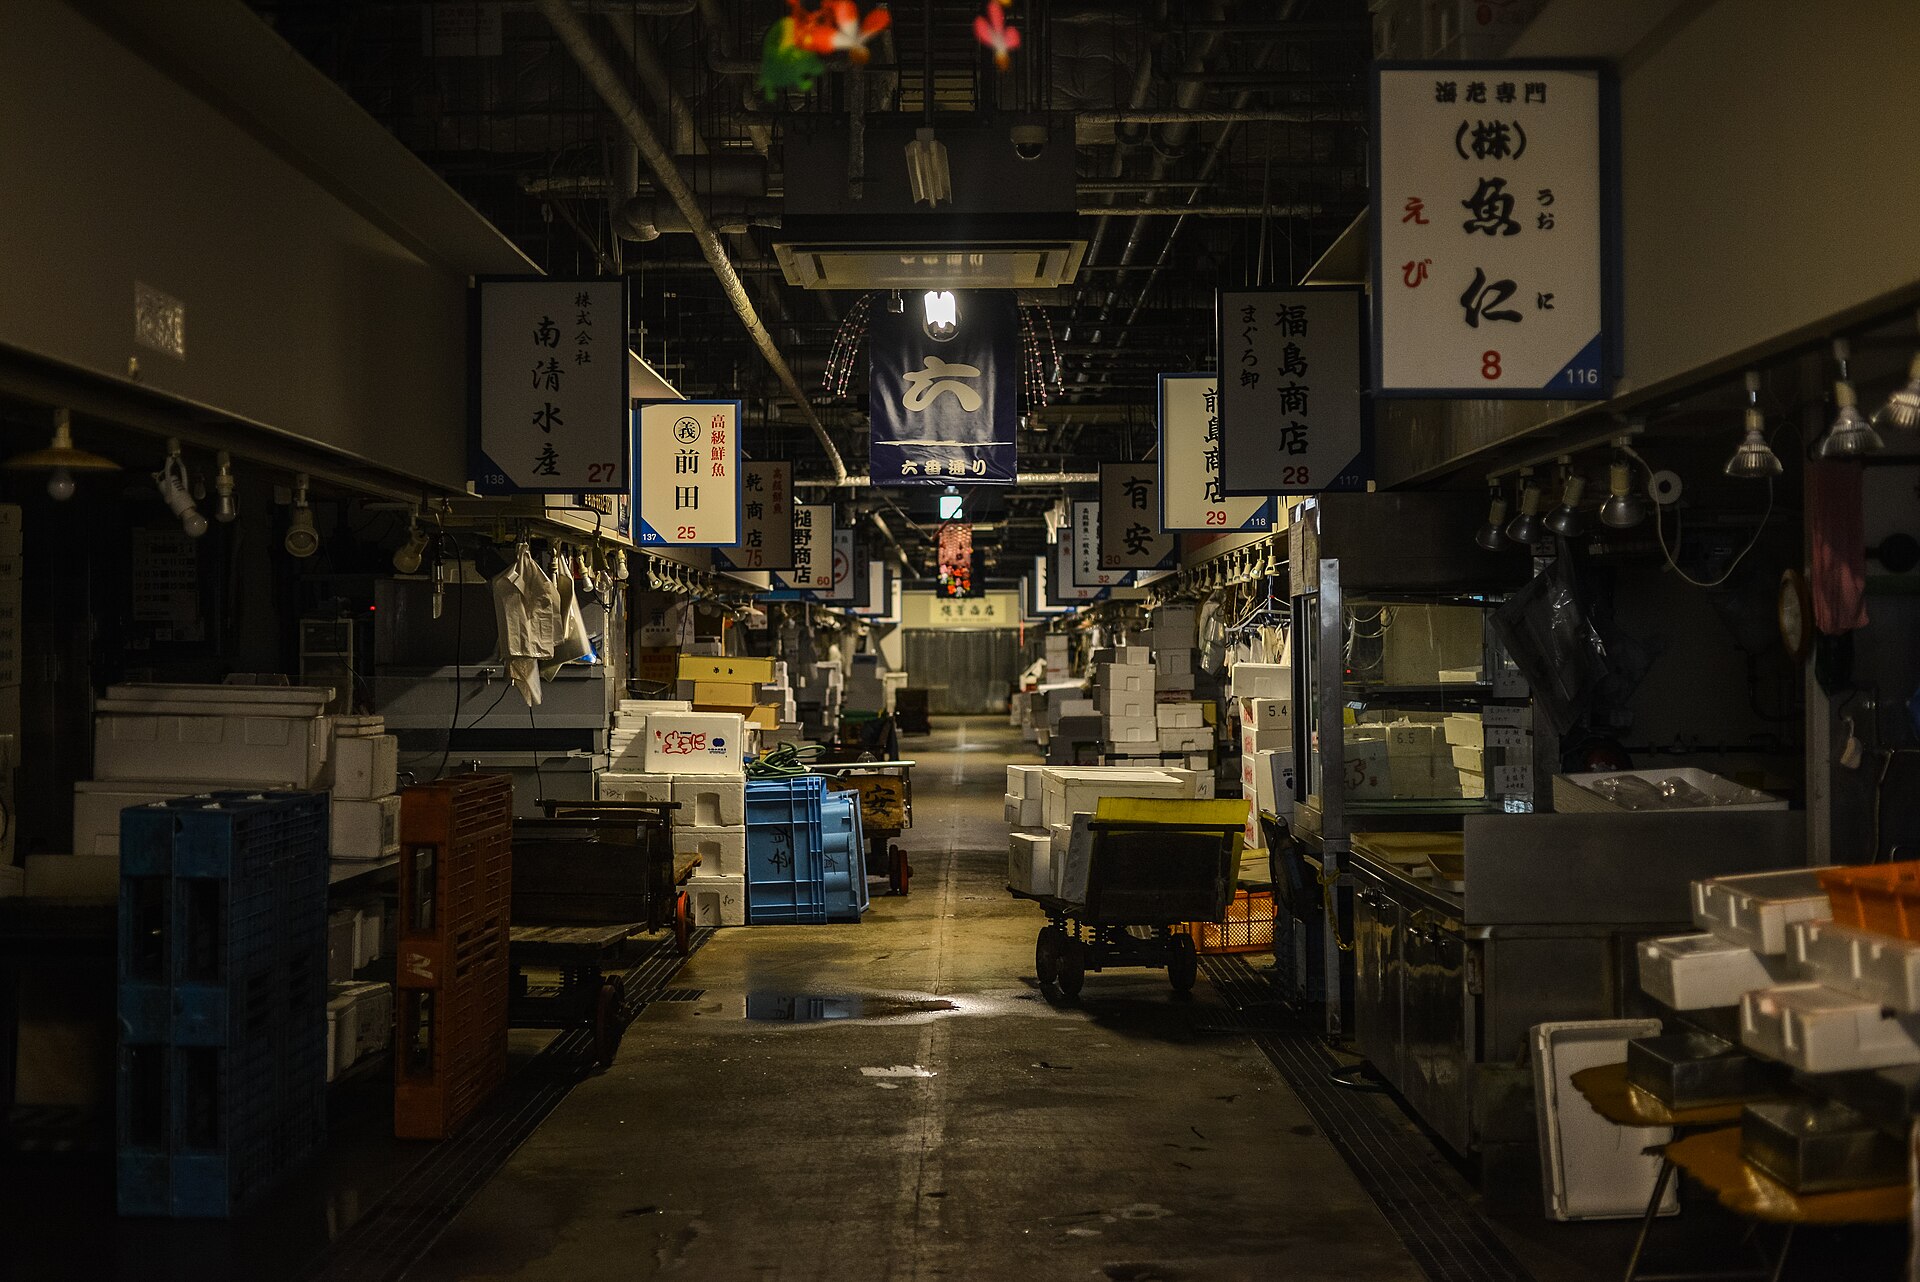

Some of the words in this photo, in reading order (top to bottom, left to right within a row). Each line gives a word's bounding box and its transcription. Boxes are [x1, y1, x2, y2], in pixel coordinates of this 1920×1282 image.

[1402, 197, 1432, 288] えび
[574, 291, 593, 366] 株式会社
[1239, 304, 1260, 390] まぐろ卸
[1481, 350, 1502, 380] 8
[902, 355, 983, 412] 六
[1274, 303, 1310, 456] 福島商店
[1567, 368, 1598, 384] 116
[531, 316, 566, 476] 南清水産
[711, 414, 726, 477] 高級鮮魚
[588, 463, 616, 483] 27
[900, 459, 987, 476] 六番通り
[1282, 466, 1309, 485] 28
[483, 475, 505, 485] 138
[1339, 475, 1359, 485] 117
[745, 473, 764, 548] 乾商店
[1122, 476, 1154, 556] 有安
[1206, 511, 1227, 525] 29
[1250, 517, 1267, 526] 118
[642, 533, 657, 541] 137
[677, 526, 696, 540] 25
[745, 549, 763, 567] 75
[1105, 555, 1121, 565] 30
[816, 576, 830, 586] 60
[1098, 575, 1110, 583] 32
[1078, 590, 1088, 598] 33
[1268, 705, 1288, 717] 5.4
